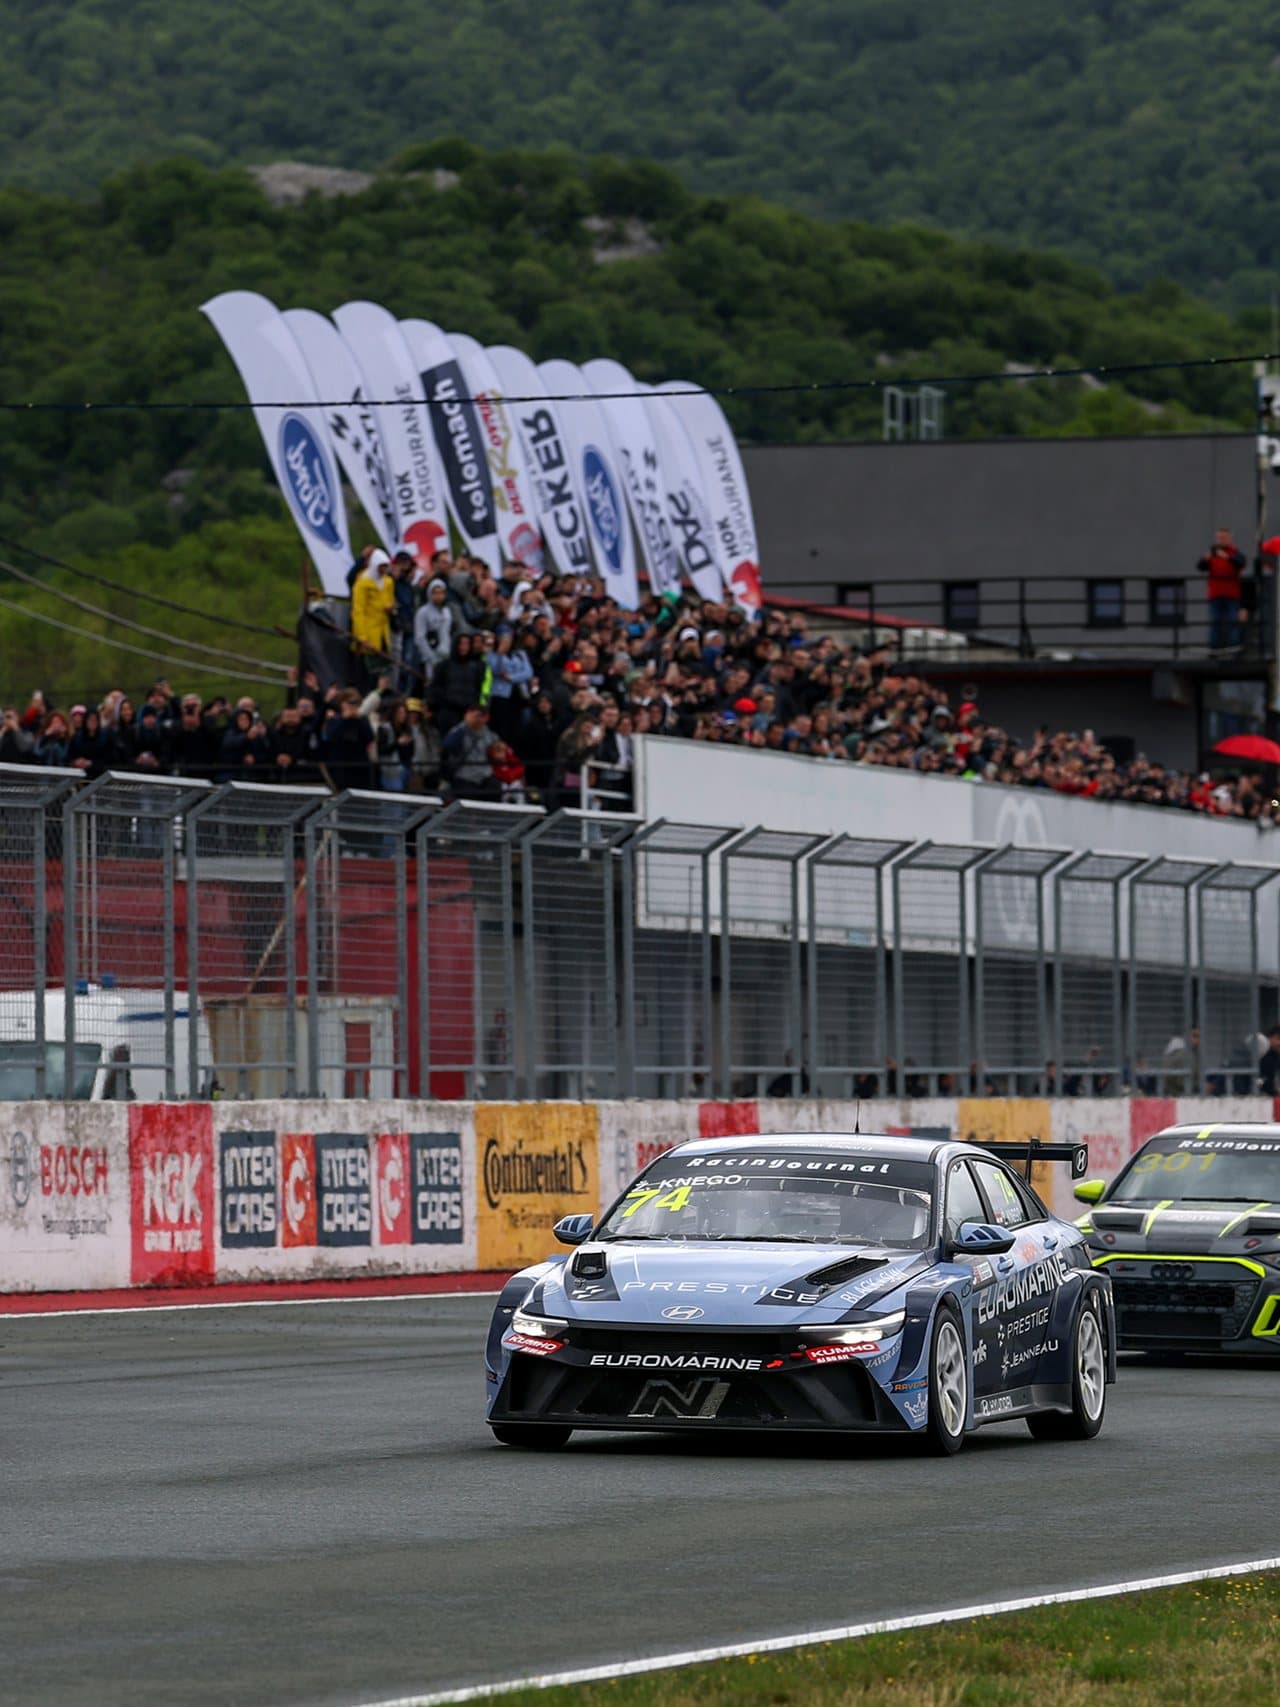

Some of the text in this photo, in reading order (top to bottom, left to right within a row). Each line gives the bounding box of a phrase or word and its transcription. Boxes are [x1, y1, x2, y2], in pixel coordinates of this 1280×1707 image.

[396, 472, 416, 516] HOK
[717, 517, 741, 559] HOK
[40, 1145, 108, 1196] BOSCH
[223, 1147, 276, 1187] INTER
[321, 1148, 370, 1187] INTER
[416, 1148, 462, 1186] INTER
[1134, 1151, 1218, 1173] 301
[143, 1152, 202, 1226] NGK
[659, 1175, 742, 1189] KNEGO
[225, 1193, 276, 1233] CARS
[322, 1192, 371, 1232] CARS
[417, 1191, 462, 1230] CARS
[622, 1186, 693, 1217] 74
[623, 1281, 820, 1304] PRESTIGE
[978, 1251, 1078, 1325] EUROMARINE
[1007, 1307, 1049, 1339] PRESTIGE
[508, 1335, 557, 1351] KUMHO
[811, 1343, 875, 1358] KUMHO
[1010, 1339, 1059, 1367] JEANNEAU
[590, 1354, 763, 1371] EUROMARINE
